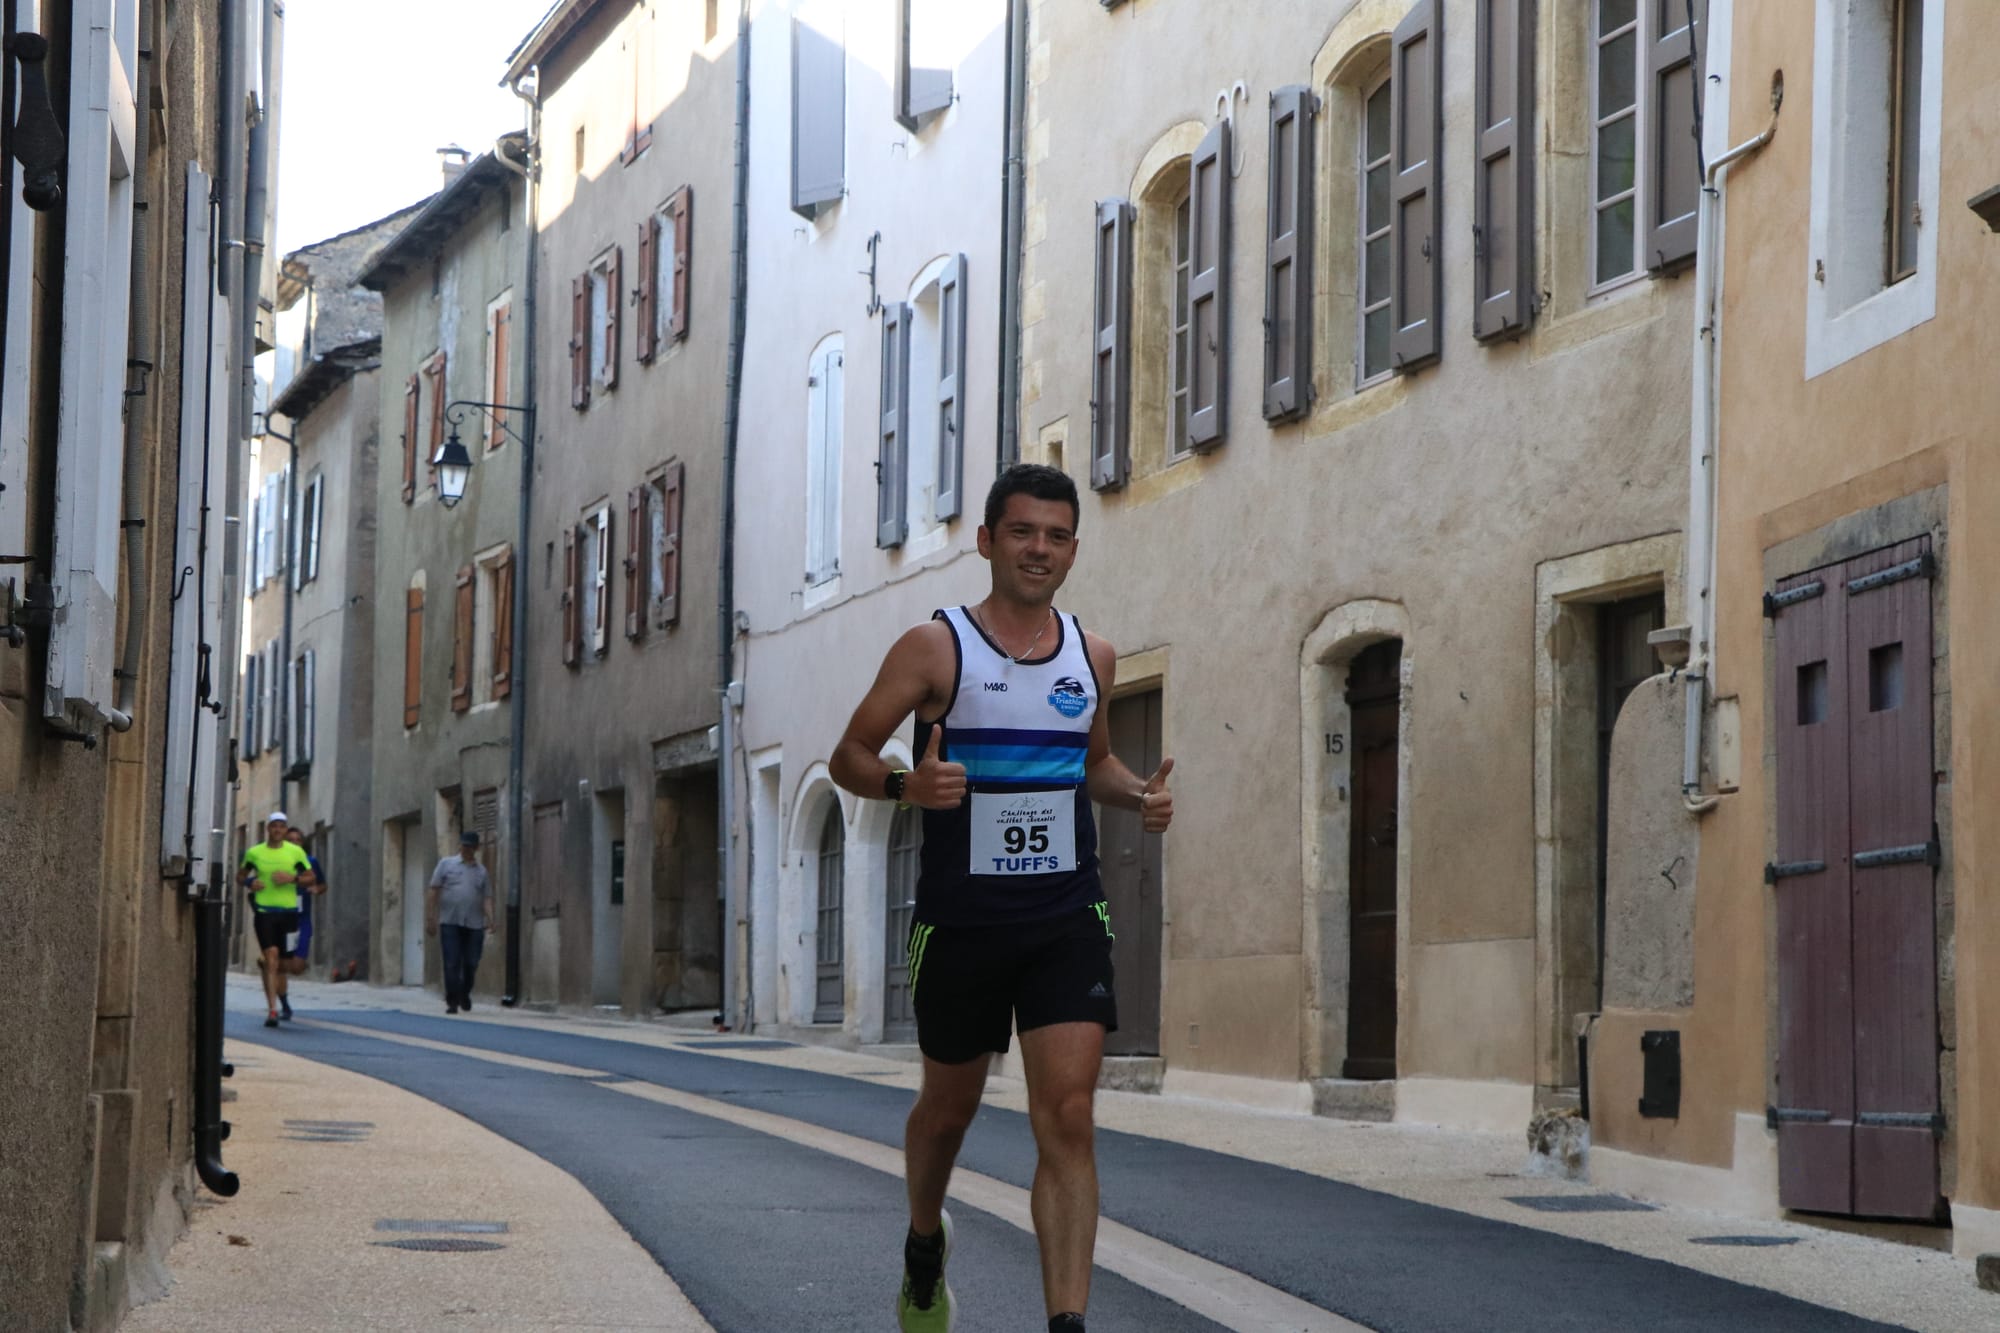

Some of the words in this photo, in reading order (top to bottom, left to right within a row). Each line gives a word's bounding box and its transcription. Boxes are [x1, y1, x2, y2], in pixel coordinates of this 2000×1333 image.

[1325, 733, 1344, 755] 15
[1003, 825, 1049, 855] 95
[991, 856, 1059, 872] TUFF'S
